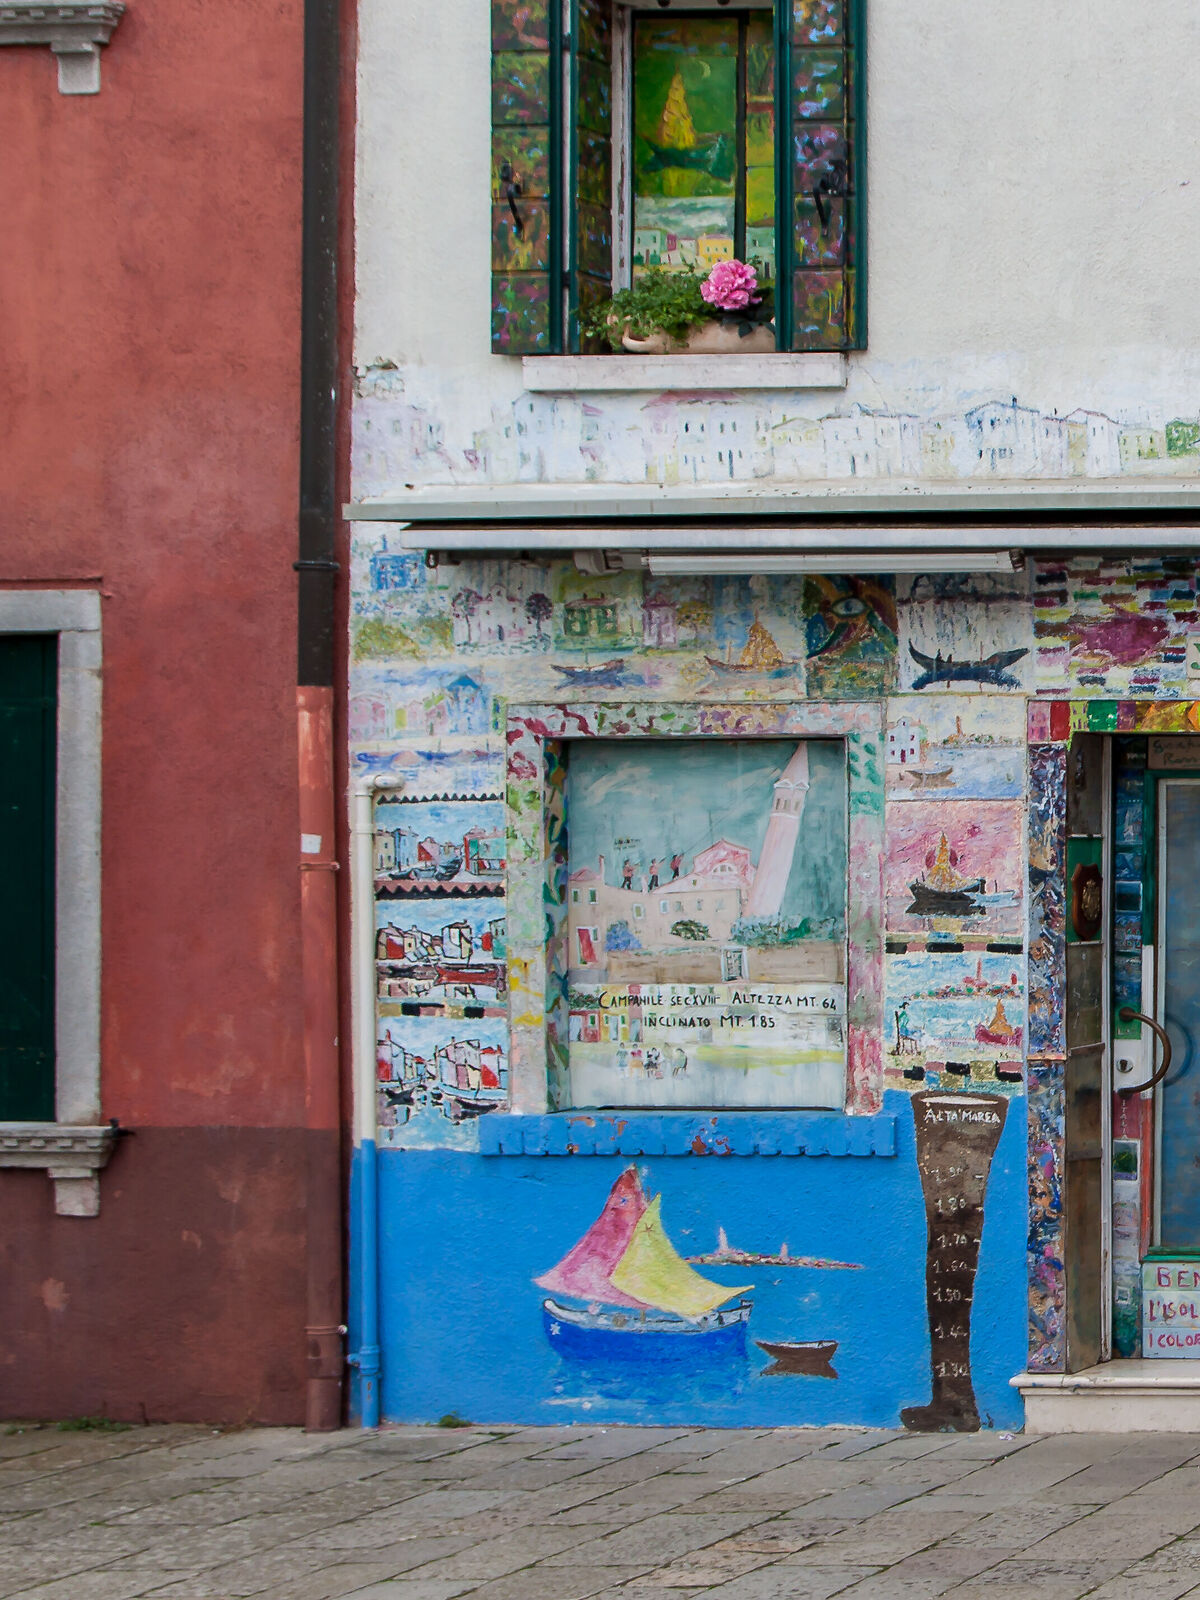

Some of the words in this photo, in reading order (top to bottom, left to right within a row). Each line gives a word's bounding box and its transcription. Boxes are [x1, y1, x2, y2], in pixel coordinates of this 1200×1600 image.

[599, 991, 664, 1009] CAMPANILE
[731, 991, 793, 1006] ALTEZZA
[822, 997, 837, 1011] 64
[643, 1015, 711, 1028] INCLINATO
[720, 1014, 744, 1028] MT.
[924, 1108, 958, 1124] ALTA
[961, 1109, 1001, 1124] MAREA
[1148, 1332, 1153, 1348] I
